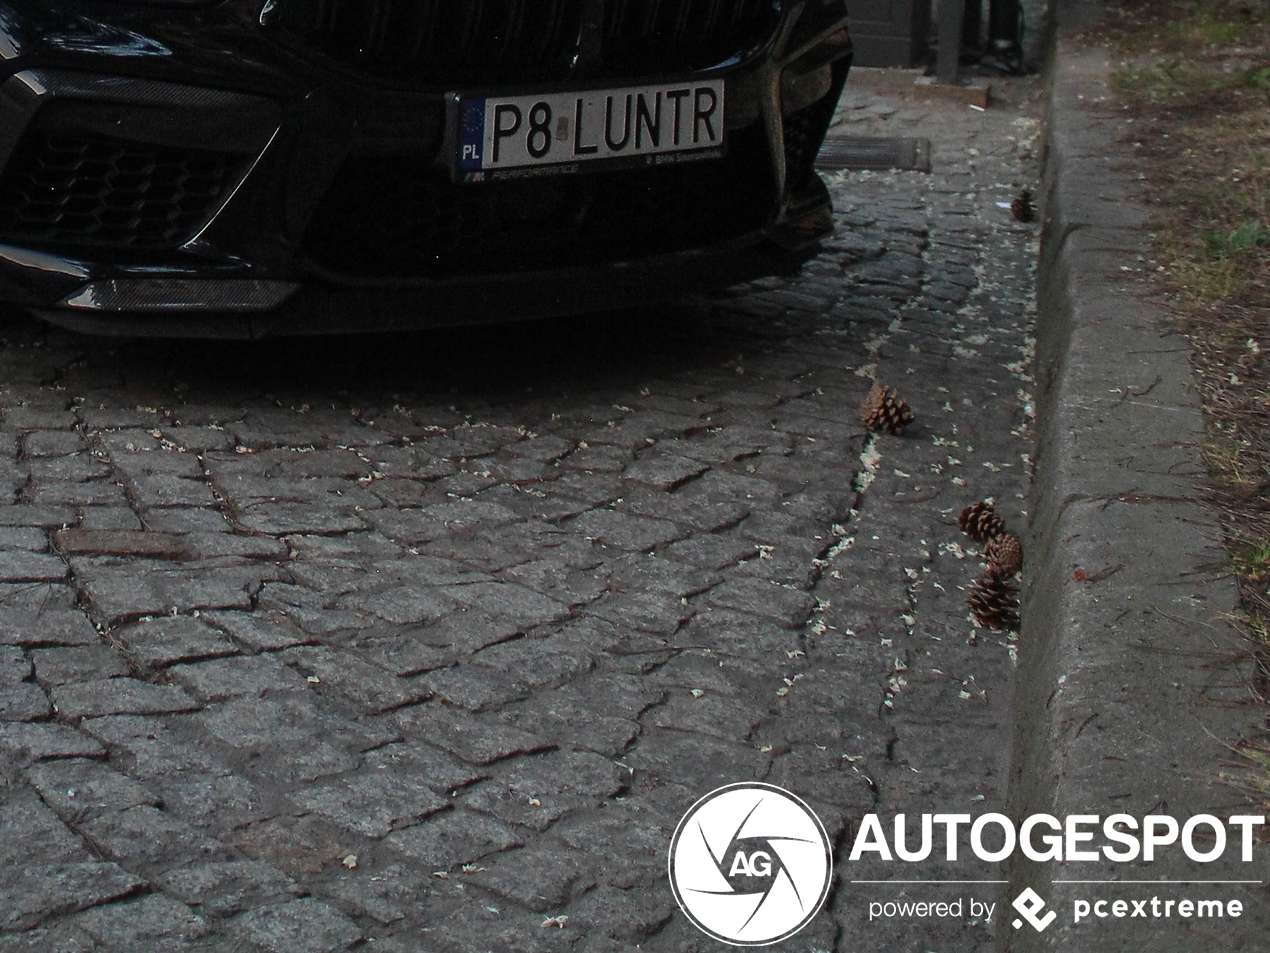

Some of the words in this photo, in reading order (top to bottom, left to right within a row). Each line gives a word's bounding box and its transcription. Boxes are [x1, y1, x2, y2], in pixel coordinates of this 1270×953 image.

[492, 101, 553, 163] P8
[573, 86, 718, 156] LUNTR
[462, 144, 480, 161] PL
[655, 153, 676, 165] BMW
[492, 164, 580, 180] PERFORMANCE
